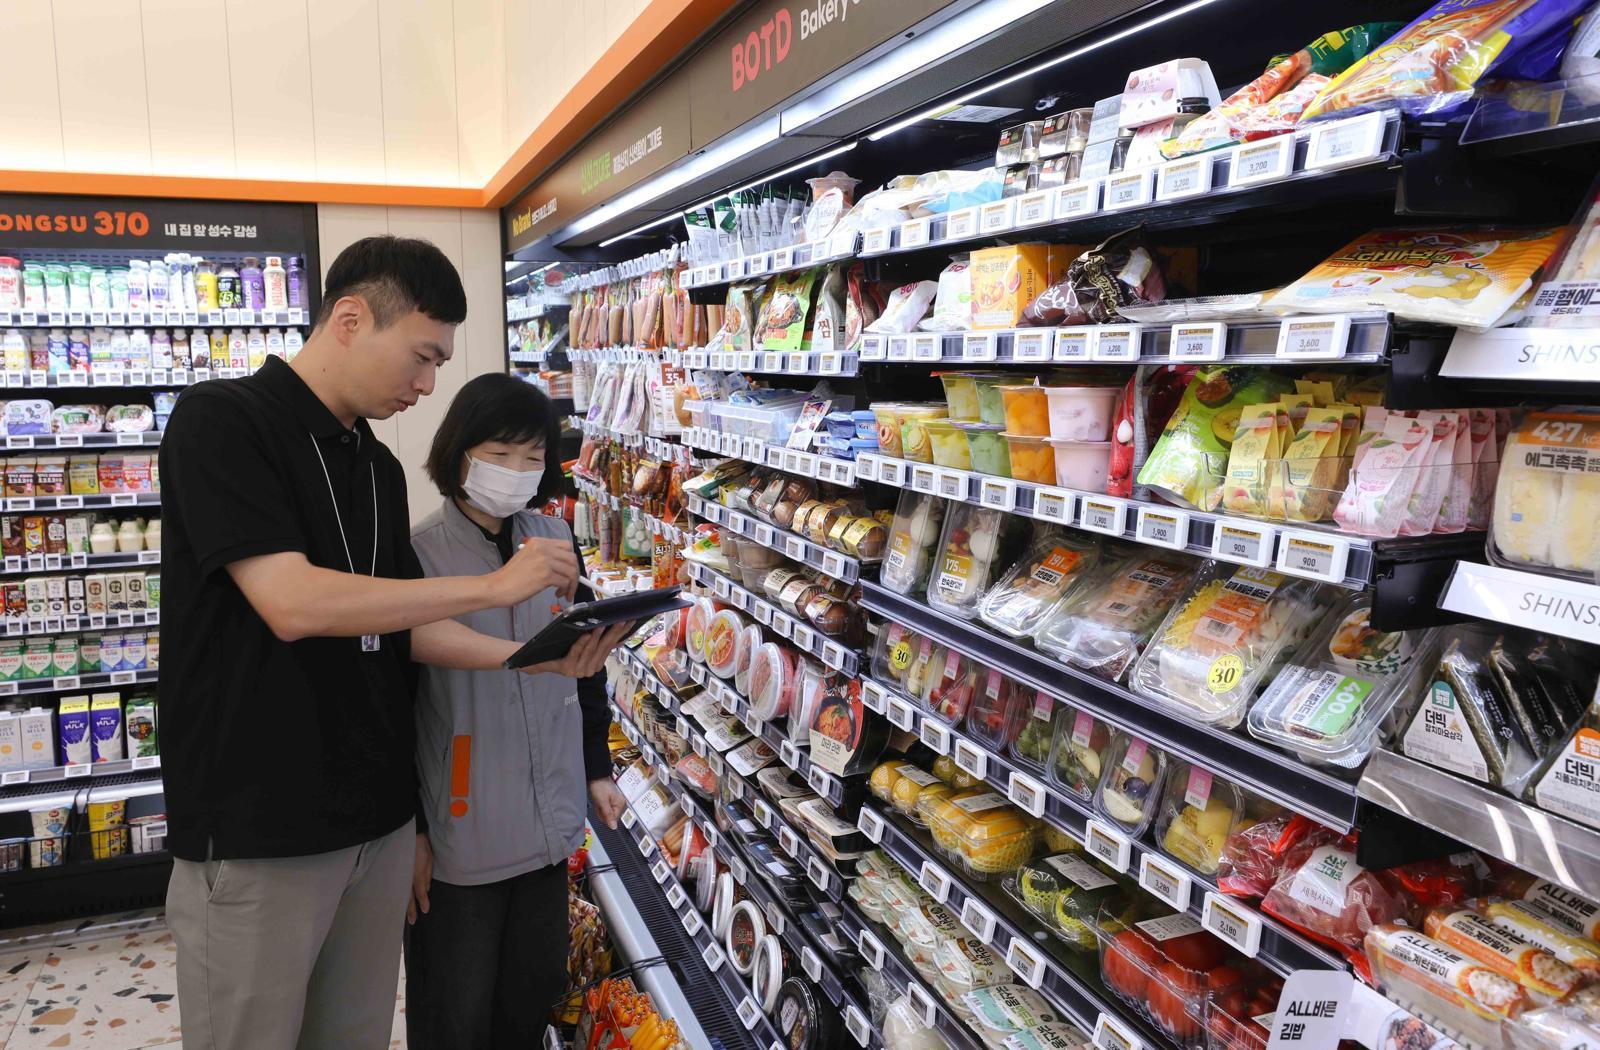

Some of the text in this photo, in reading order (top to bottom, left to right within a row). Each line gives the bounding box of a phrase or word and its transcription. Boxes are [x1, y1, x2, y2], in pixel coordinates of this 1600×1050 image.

[731, 8, 792, 92] BOTD
[94, 210, 149, 237] 310
[164, 223, 257, 238] 내 집 앞 성수 감성
[1531, 421, 1584, 443] 427
[1525, 452, 1587, 472] 에그촉촉
[1233, 543, 1246, 553] 900
[945, 558, 959, 571] 175
[1303, 557, 1316, 567] 900
[1519, 592, 1600, 627] SHINS
[1212, 666, 1236, 684] 30
[1328, 682, 1361, 714] 400
[1425, 708, 1447, 728] 더빅
[1565, 758, 1595, 781] 더빅
[1220, 921, 1238, 937] 2,180
[1285, 1000, 1338, 1018] ALL바른
[1280, 1023, 1305, 1041] 김밥
